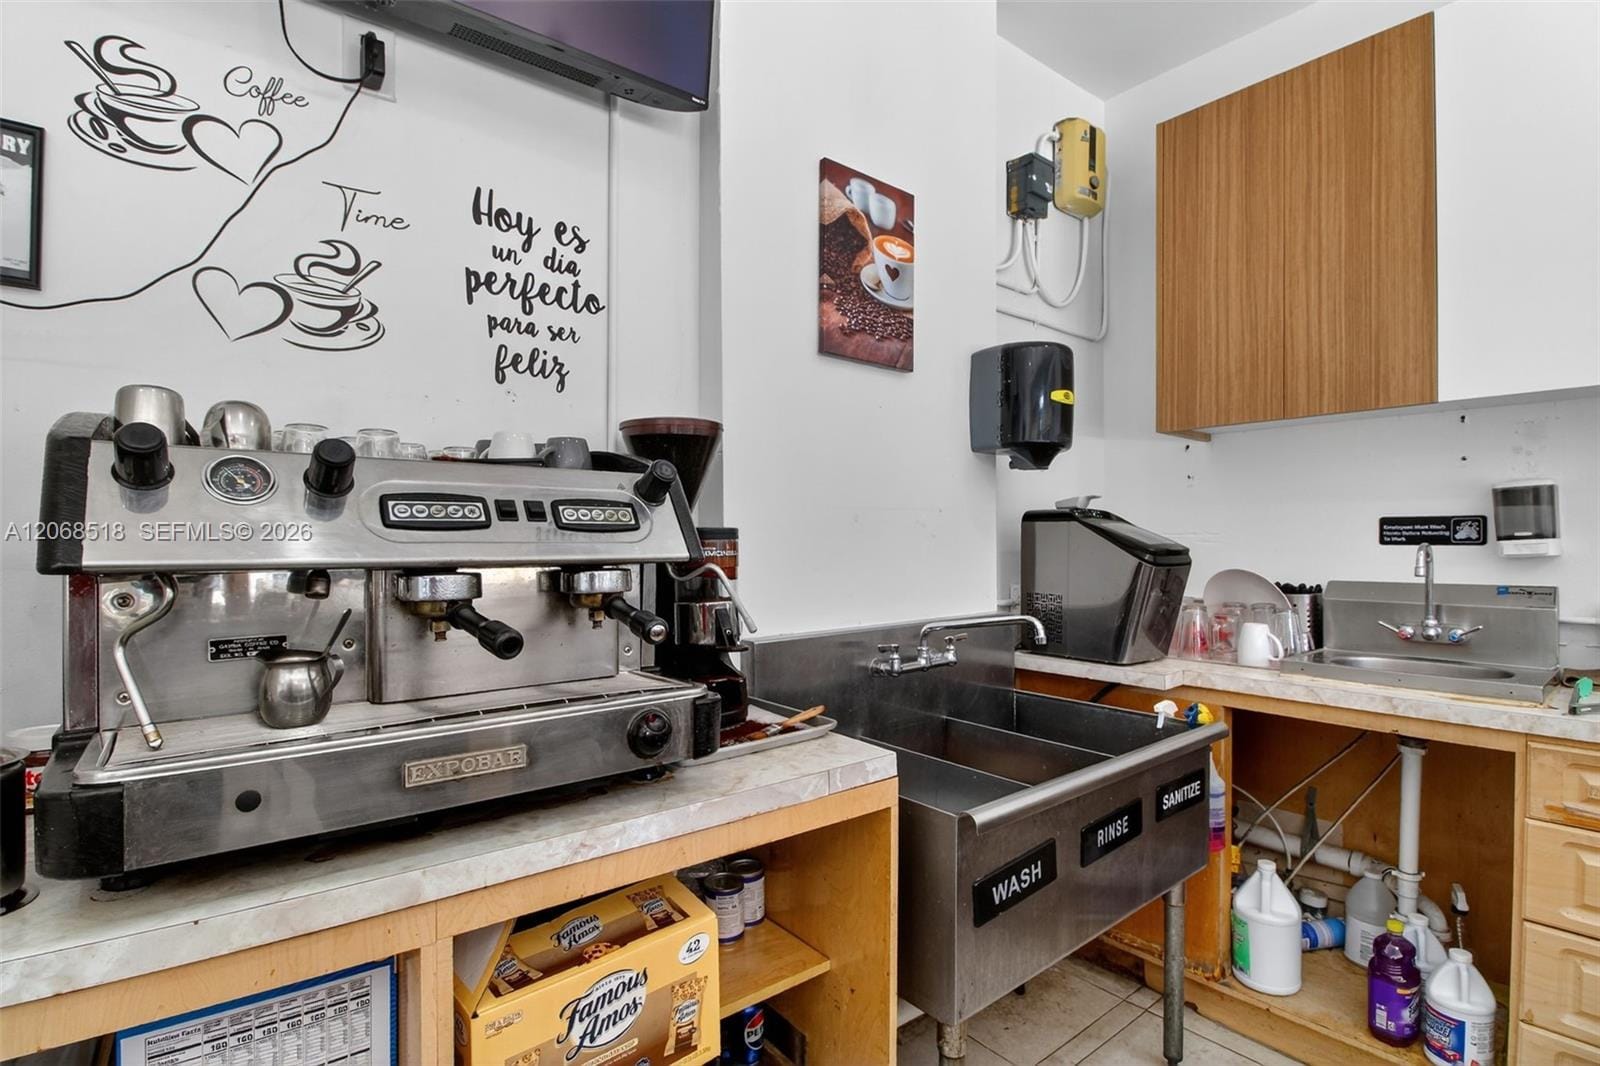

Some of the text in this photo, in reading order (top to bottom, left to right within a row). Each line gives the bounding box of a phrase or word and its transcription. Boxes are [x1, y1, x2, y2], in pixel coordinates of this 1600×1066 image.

[224, 66, 309, 116] Coffee
[321, 181, 411, 232] Time
[472, 186, 590, 254] Hoy es
[492, 245, 522, 265] un
[465, 267, 606, 316] perfecto
[487, 314, 580, 343] para ser
[494, 344, 570, 393] feliz
[410, 750, 522, 782] EXPOBAR
[1162, 780, 1201, 810] SANITIZE
[1097, 815, 1129, 847] RINSE
[992, 860, 1042, 905] WASH
[550, 914, 599, 948] Famous
[563, 925, 600, 951] Amos
[686, 938, 701, 954] 42
[556, 967, 648, 1044] Famous
[565, 997, 643, 1061] Amos
